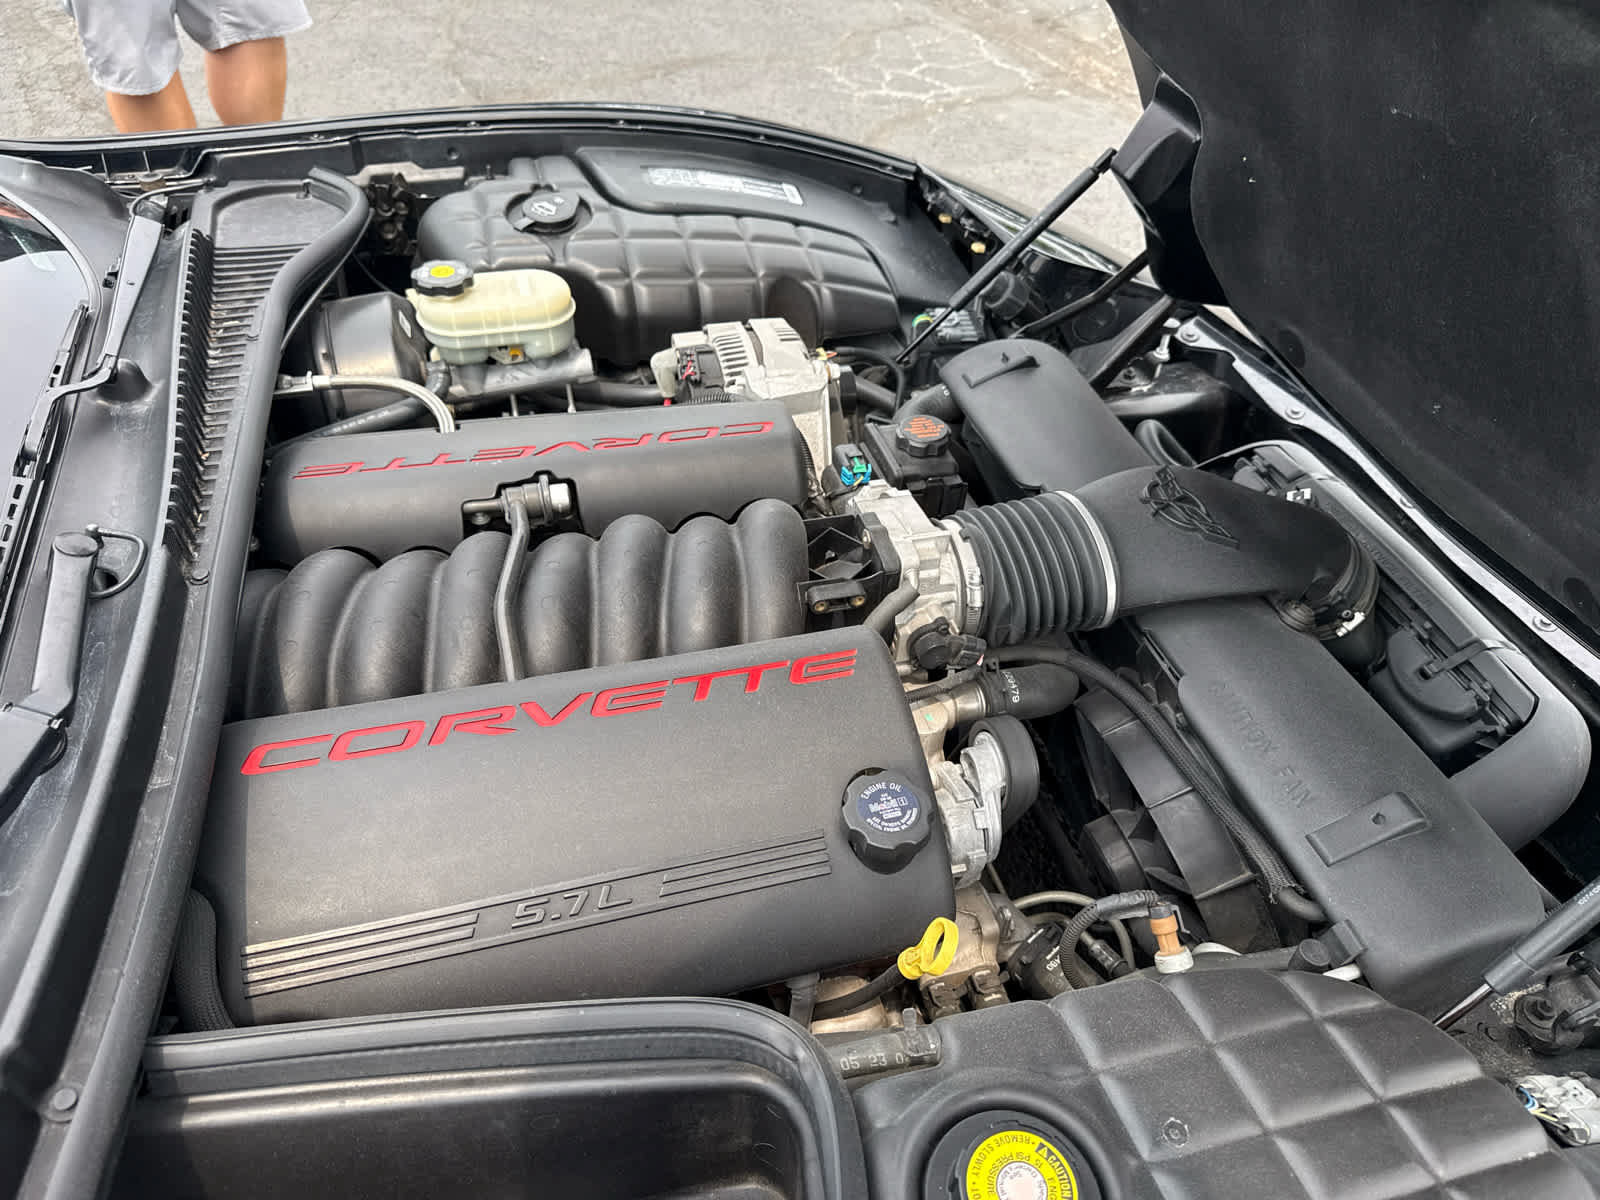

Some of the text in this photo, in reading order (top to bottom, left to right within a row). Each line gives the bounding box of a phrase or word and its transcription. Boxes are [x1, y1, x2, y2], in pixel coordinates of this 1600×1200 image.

[292, 420, 775, 480] CORVETTE
[240, 648, 858, 777] CORVETTE
[860, 781, 887, 800] ENGINE
[889, 782, 903, 793] OIL
[511, 884, 633, 929] 5.7L
[840, 1056, 860, 1071] 05
[869, 1053, 888, 1068] 23
[973, 1134, 1031, 1176] REMOVE SLOWLY
[987, 1152, 1014, 1196] PRESSURE
[1016, 1151, 1031, 1162] PSI
[1034, 1159, 1043, 1169] 15
[1048, 1155, 1071, 1198] CAUTION
